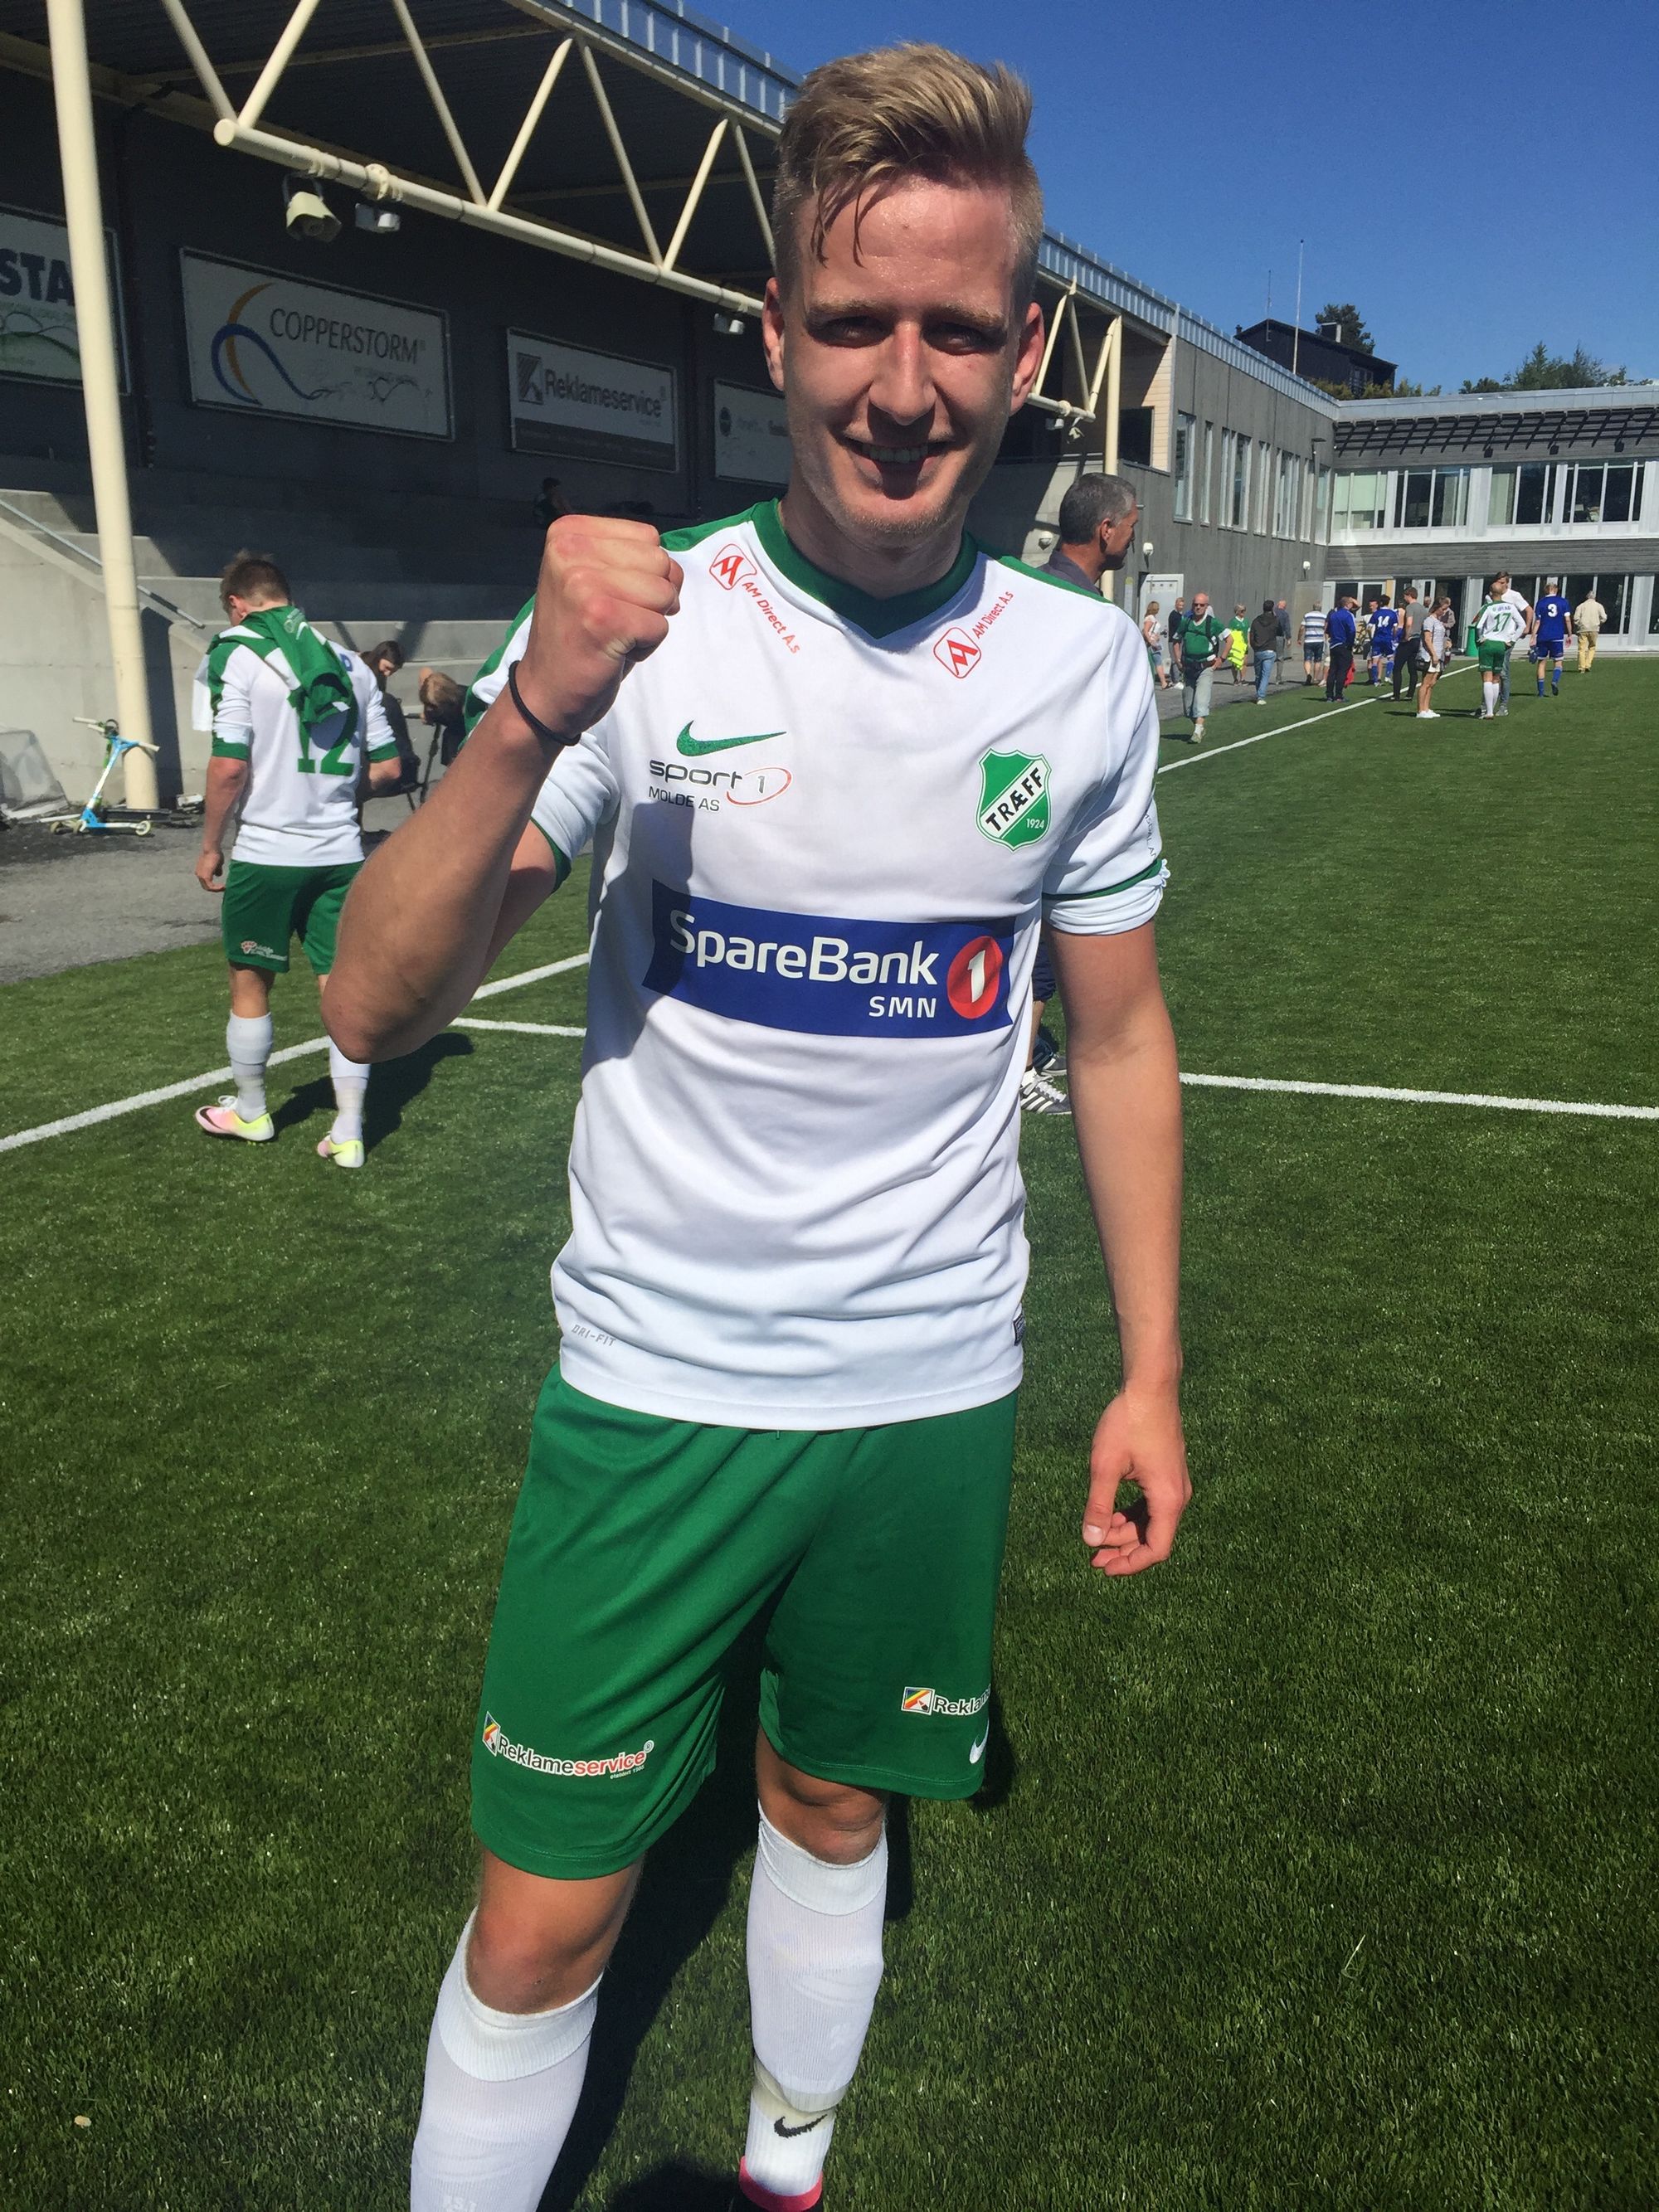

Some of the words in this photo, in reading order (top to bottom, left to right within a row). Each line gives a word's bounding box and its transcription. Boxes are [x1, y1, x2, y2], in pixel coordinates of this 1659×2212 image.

[270, 308, 417, 364] COPPERSTORM
[544, 368, 662, 418] Reklameservice
[742, 581, 762, 597] AM
[757, 599, 787, 634] Direct
[972, 622, 988, 639] AM
[981, 603, 1005, 625] Direct
[1377, 615, 1390, 628] 14
[1493, 612, 1511, 632] 17
[1547, 603, 1558, 617] 3
[649, 759, 742, 789] sport
[757, 775, 766, 794] 1
[649, 785, 695, 808] MOLDE
[698, 797, 720, 812] AS
[985, 767, 1043, 832] TRÆFF
[1025, 818, 1044, 829] 1924
[669, 909, 940, 985] SpareBank
[967, 949, 987, 1003] 1
[868, 995, 937, 1018] SMN
[572, 1325, 617, 1346] DRI-FIT
